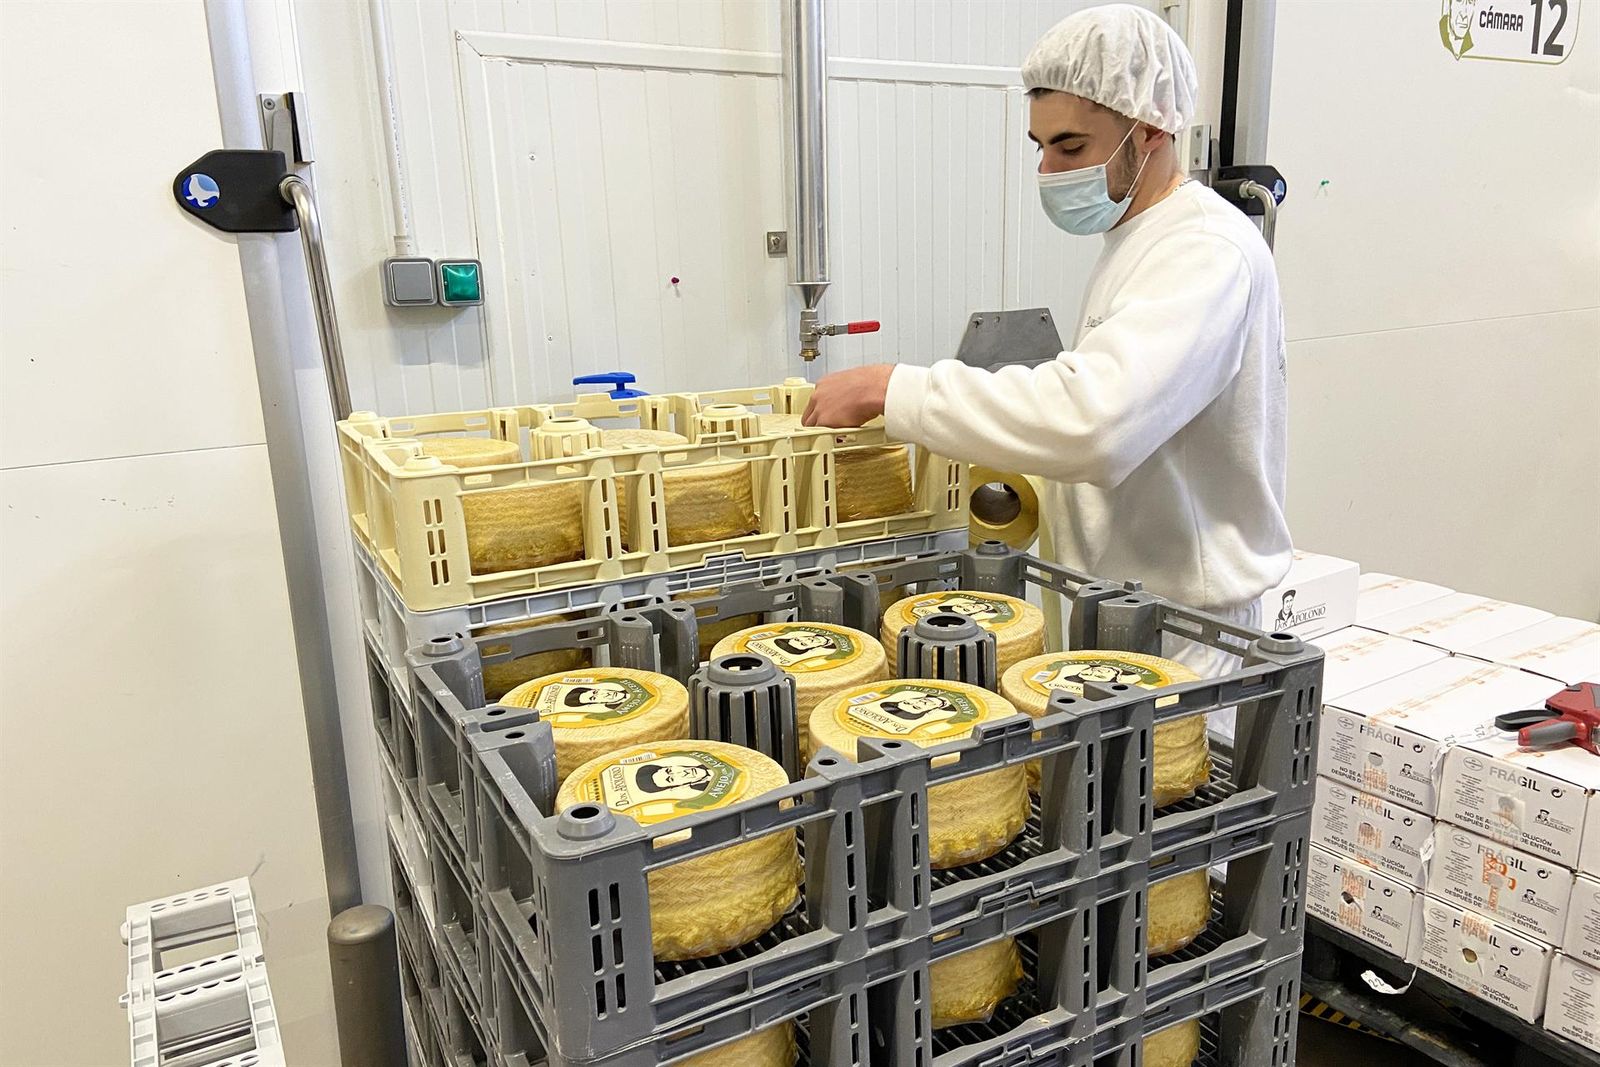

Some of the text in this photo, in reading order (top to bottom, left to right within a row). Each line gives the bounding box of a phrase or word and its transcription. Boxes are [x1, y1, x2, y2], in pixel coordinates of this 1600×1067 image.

[1479, 0, 1568, 57] CÁMARA 12
[1289, 606, 1326, 626] APOLONIO
[1048, 683, 1081, 691] LONIO
[1359, 724, 1404, 748] FRÁGIL
[1489, 766, 1541, 792] FRÁGIL
[1389, 784, 1415, 797] OLUCIÓN
[1455, 813, 1483, 827] DESPUÉS
[1530, 841, 1561, 856] ENTREGA
[1382, 856, 1405, 869] OLUCIÓN
[1444, 889, 1471, 903] DESPUÉS
[1517, 919, 1547, 935] ENTREGA
[1513, 911, 1538, 925] LUCIÓN
[1362, 925, 1385, 939] OLUCIÓN
[1453, 918, 1500, 948] FIL
[1490, 993, 1518, 1011] ENTREGA
